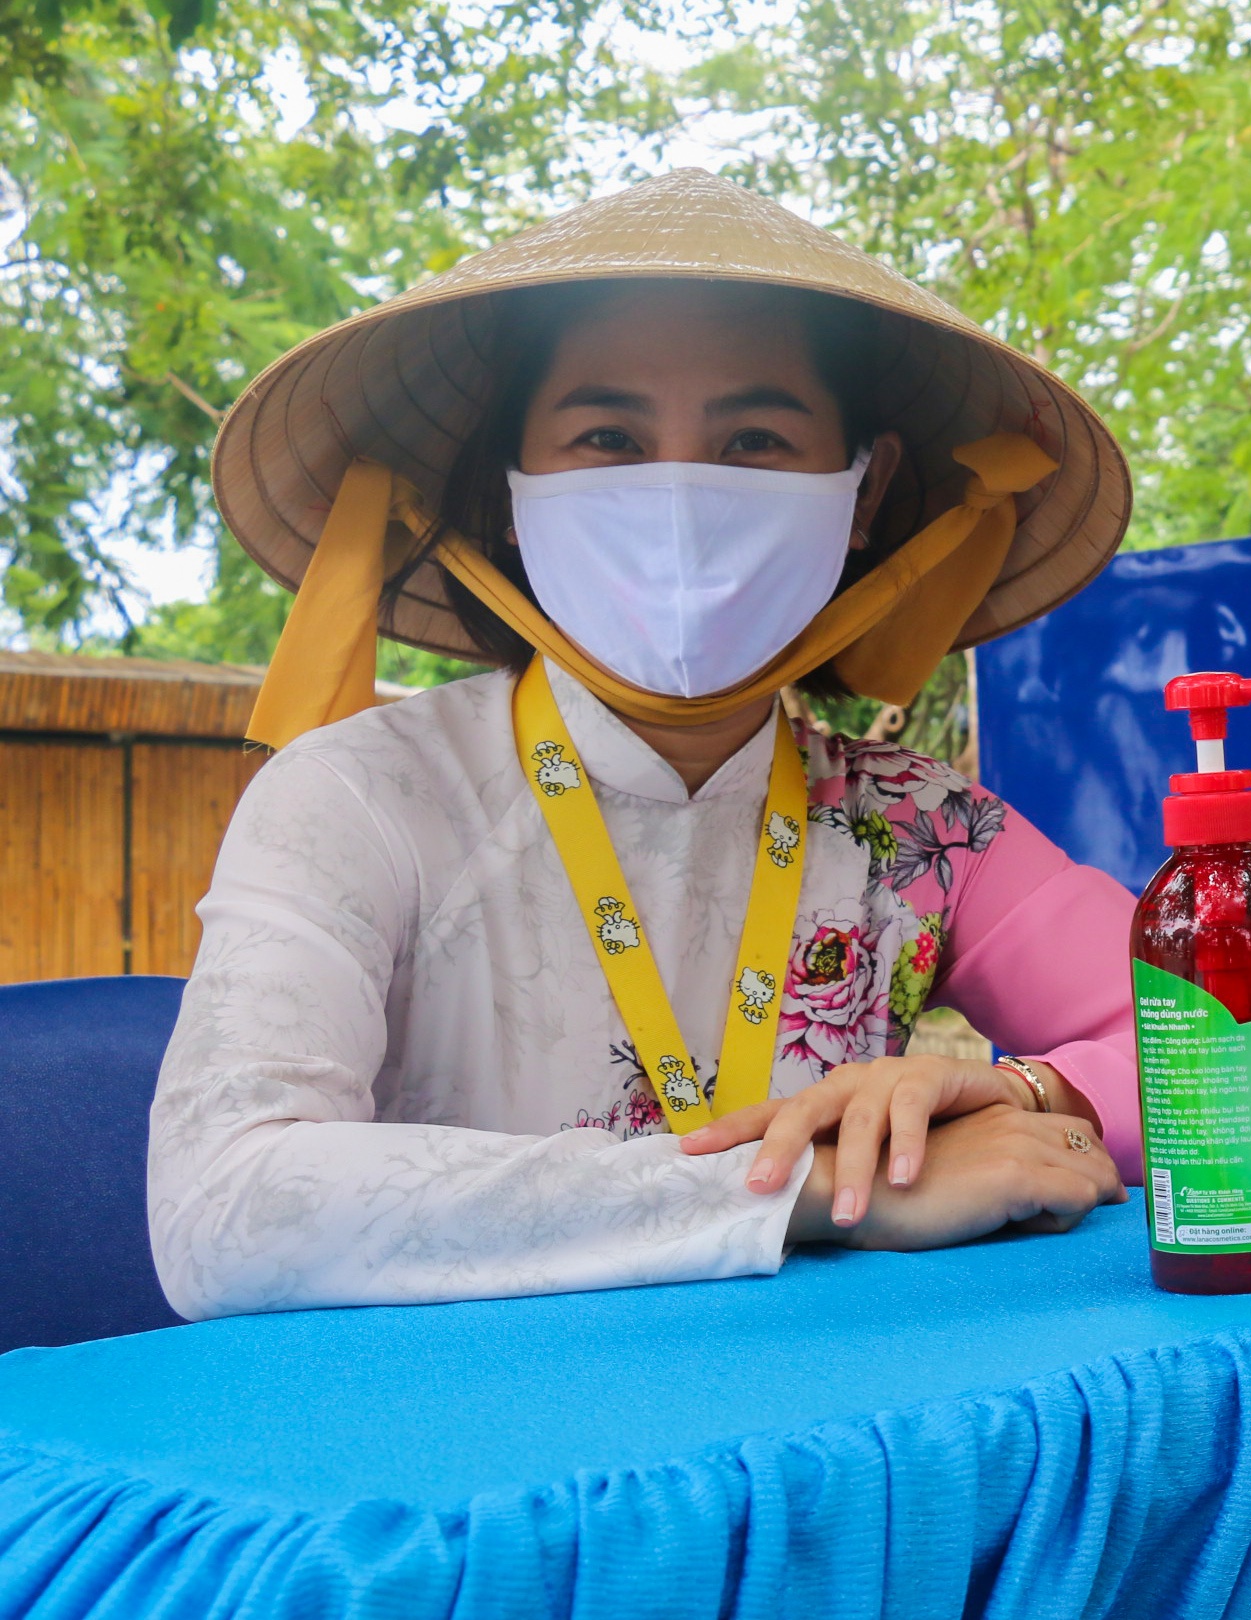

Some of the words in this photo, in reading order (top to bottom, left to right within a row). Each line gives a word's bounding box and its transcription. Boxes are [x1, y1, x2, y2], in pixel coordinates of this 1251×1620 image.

[1162, 998, 1176, 1008] tay
[1159, 1009, 1182, 1020] dùng
[1183, 1007, 1209, 1017] nước
[1201, 1226, 1220, 1237] hàng
[1221, 1226, 1248, 1236] online:
